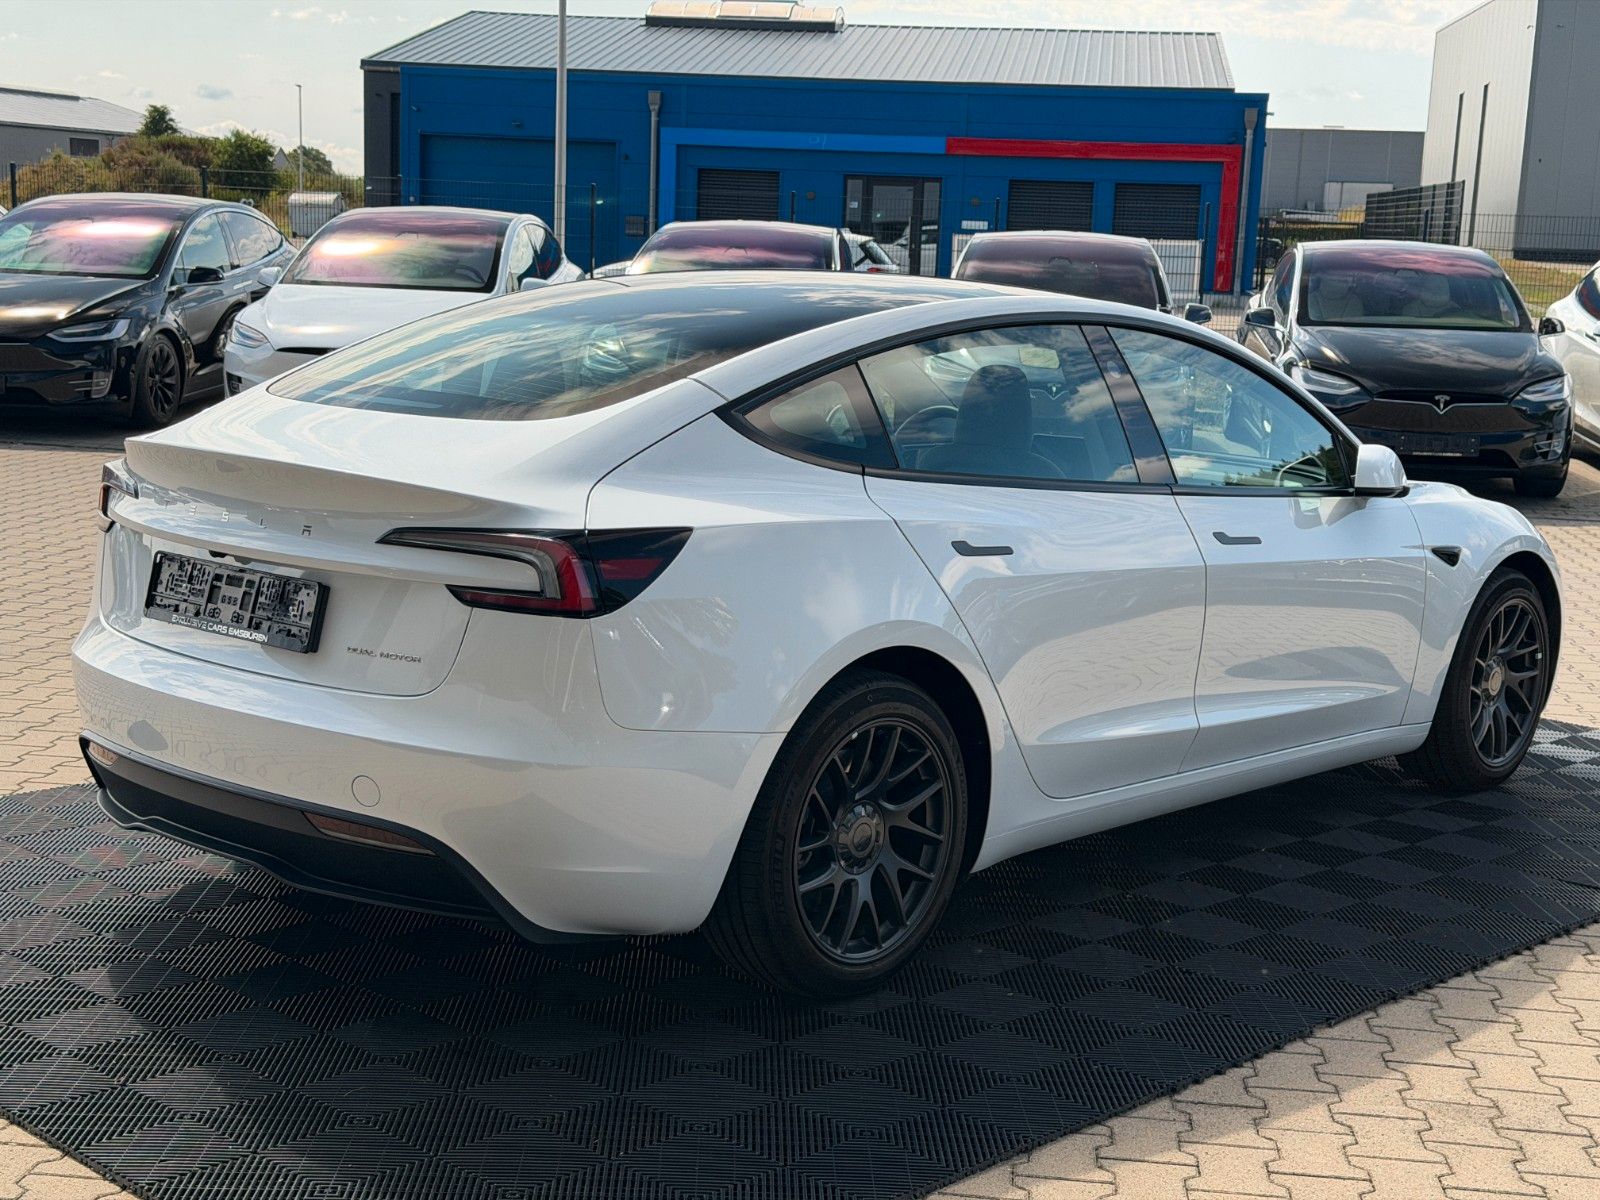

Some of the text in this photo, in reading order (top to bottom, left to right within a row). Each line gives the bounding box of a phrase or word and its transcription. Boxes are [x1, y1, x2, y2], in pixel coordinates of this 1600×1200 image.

[171, 614, 207, 629] EXCLUSIVE
[207, 622, 228, 634] CARS
[379, 651, 422, 663] MOTOR
